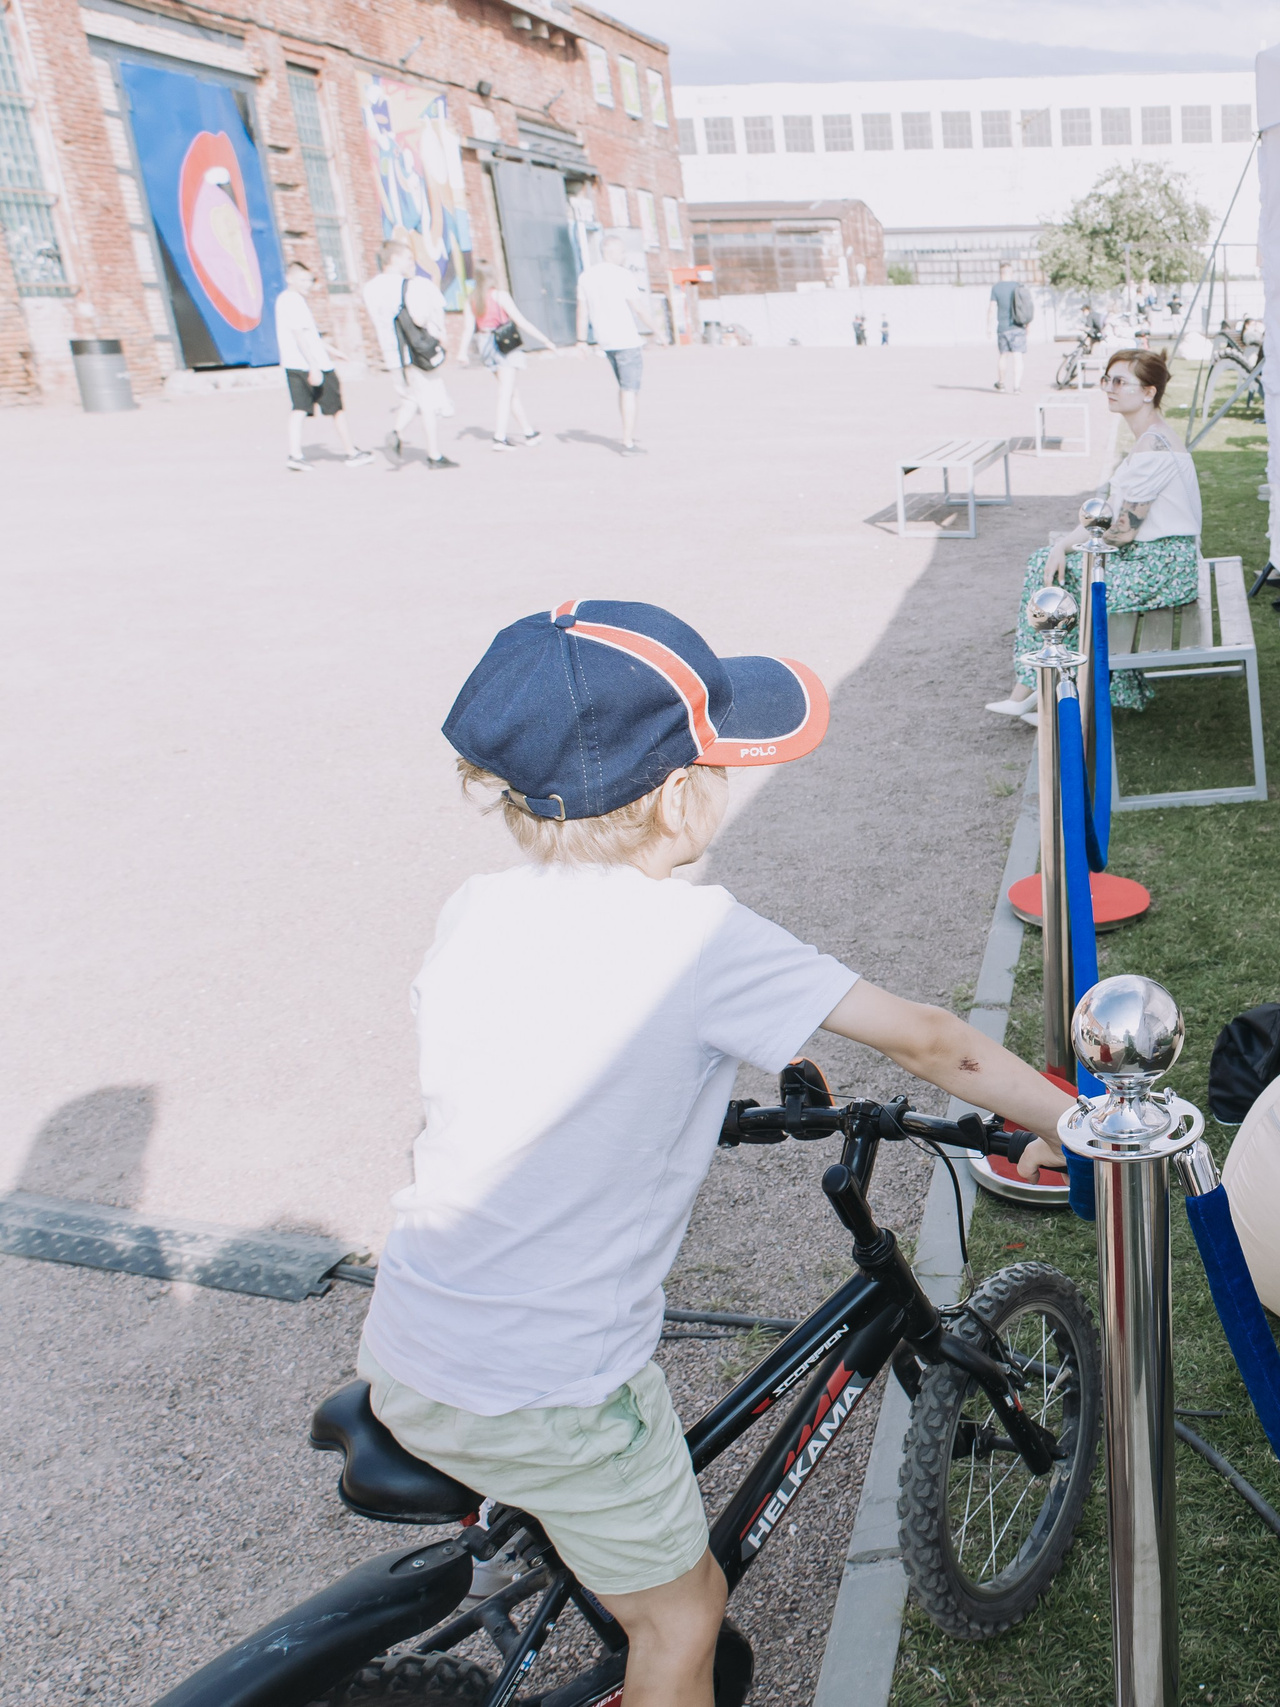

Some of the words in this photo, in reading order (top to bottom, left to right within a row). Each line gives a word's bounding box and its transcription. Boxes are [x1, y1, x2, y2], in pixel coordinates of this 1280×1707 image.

[740, 745, 777, 759] POLO
[772, 1323, 850, 1398] SCORPION
[747, 1385, 864, 1549] HELKAMA
